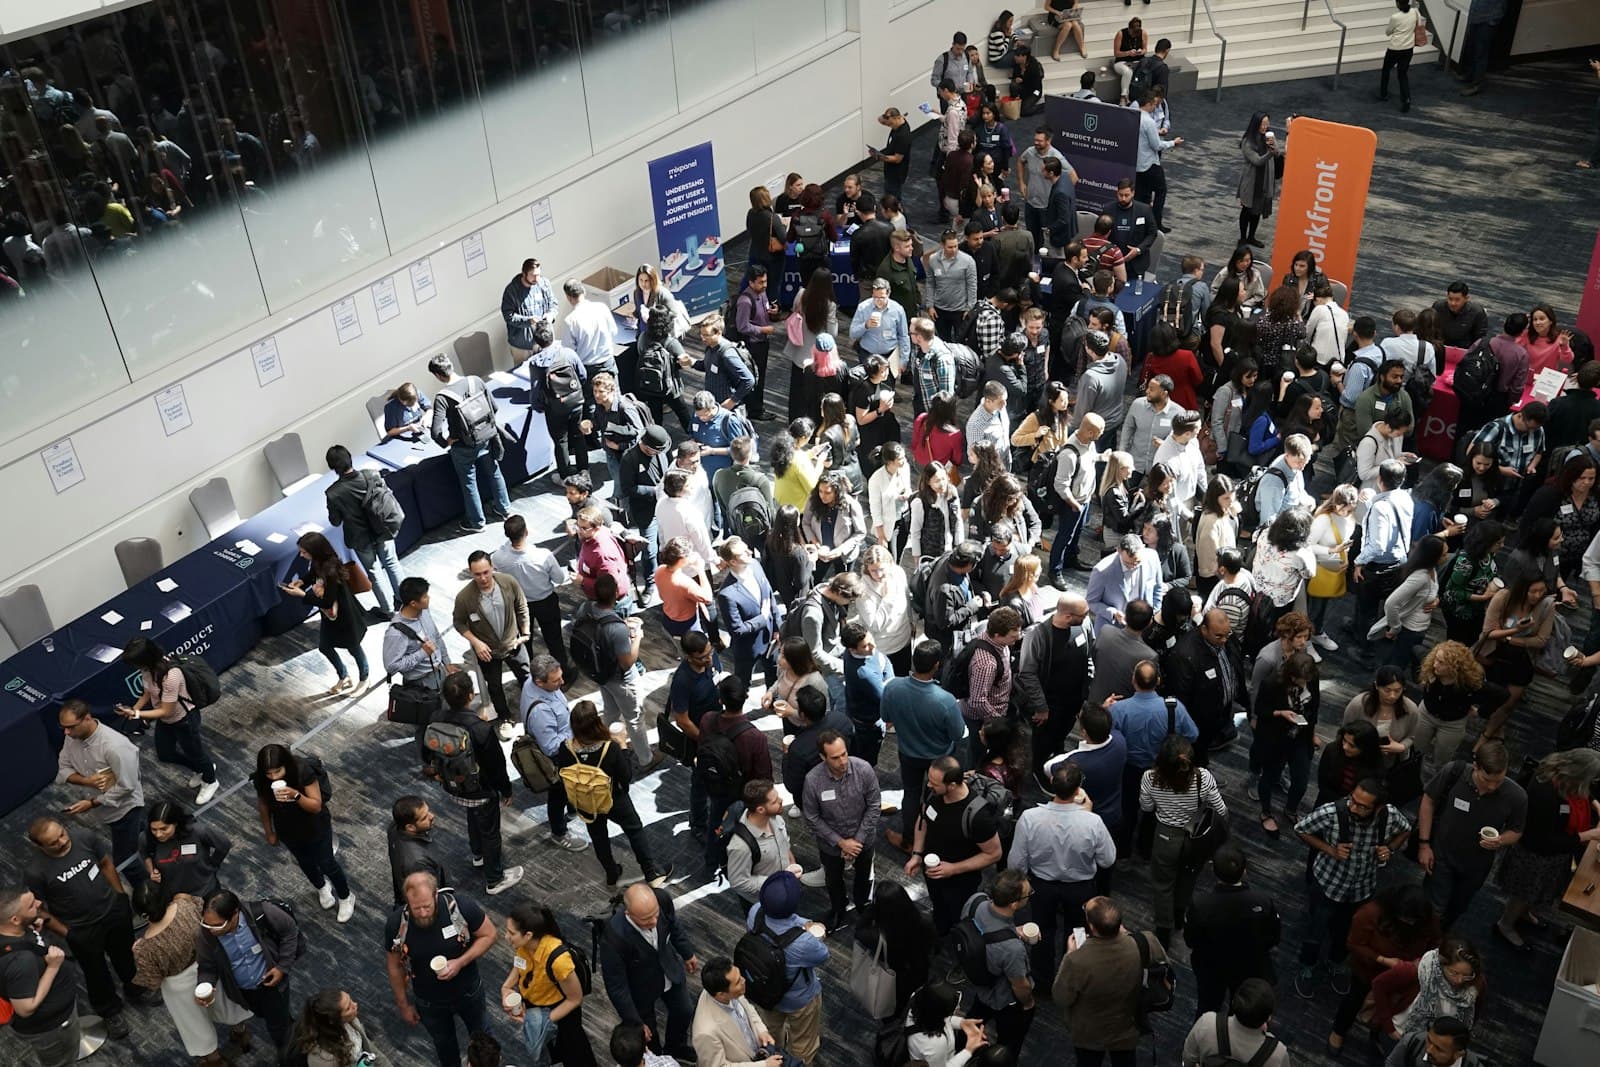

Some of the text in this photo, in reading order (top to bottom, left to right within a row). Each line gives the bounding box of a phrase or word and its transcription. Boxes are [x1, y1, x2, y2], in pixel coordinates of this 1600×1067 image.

[1062, 131, 1119, 147] PRODUCT SCHOOL
[669, 159, 697, 175] mixpanel
[665, 178, 704, 196] UNDERSTAND
[666, 188, 705, 206] EVERY USER'S
[666, 196, 708, 216] JOURNEY WITH
[663, 204, 713, 227] INSTANT INSIGHTS
[1304, 159, 1339, 272] orkfront
[56, 859, 91, 882] Value.
